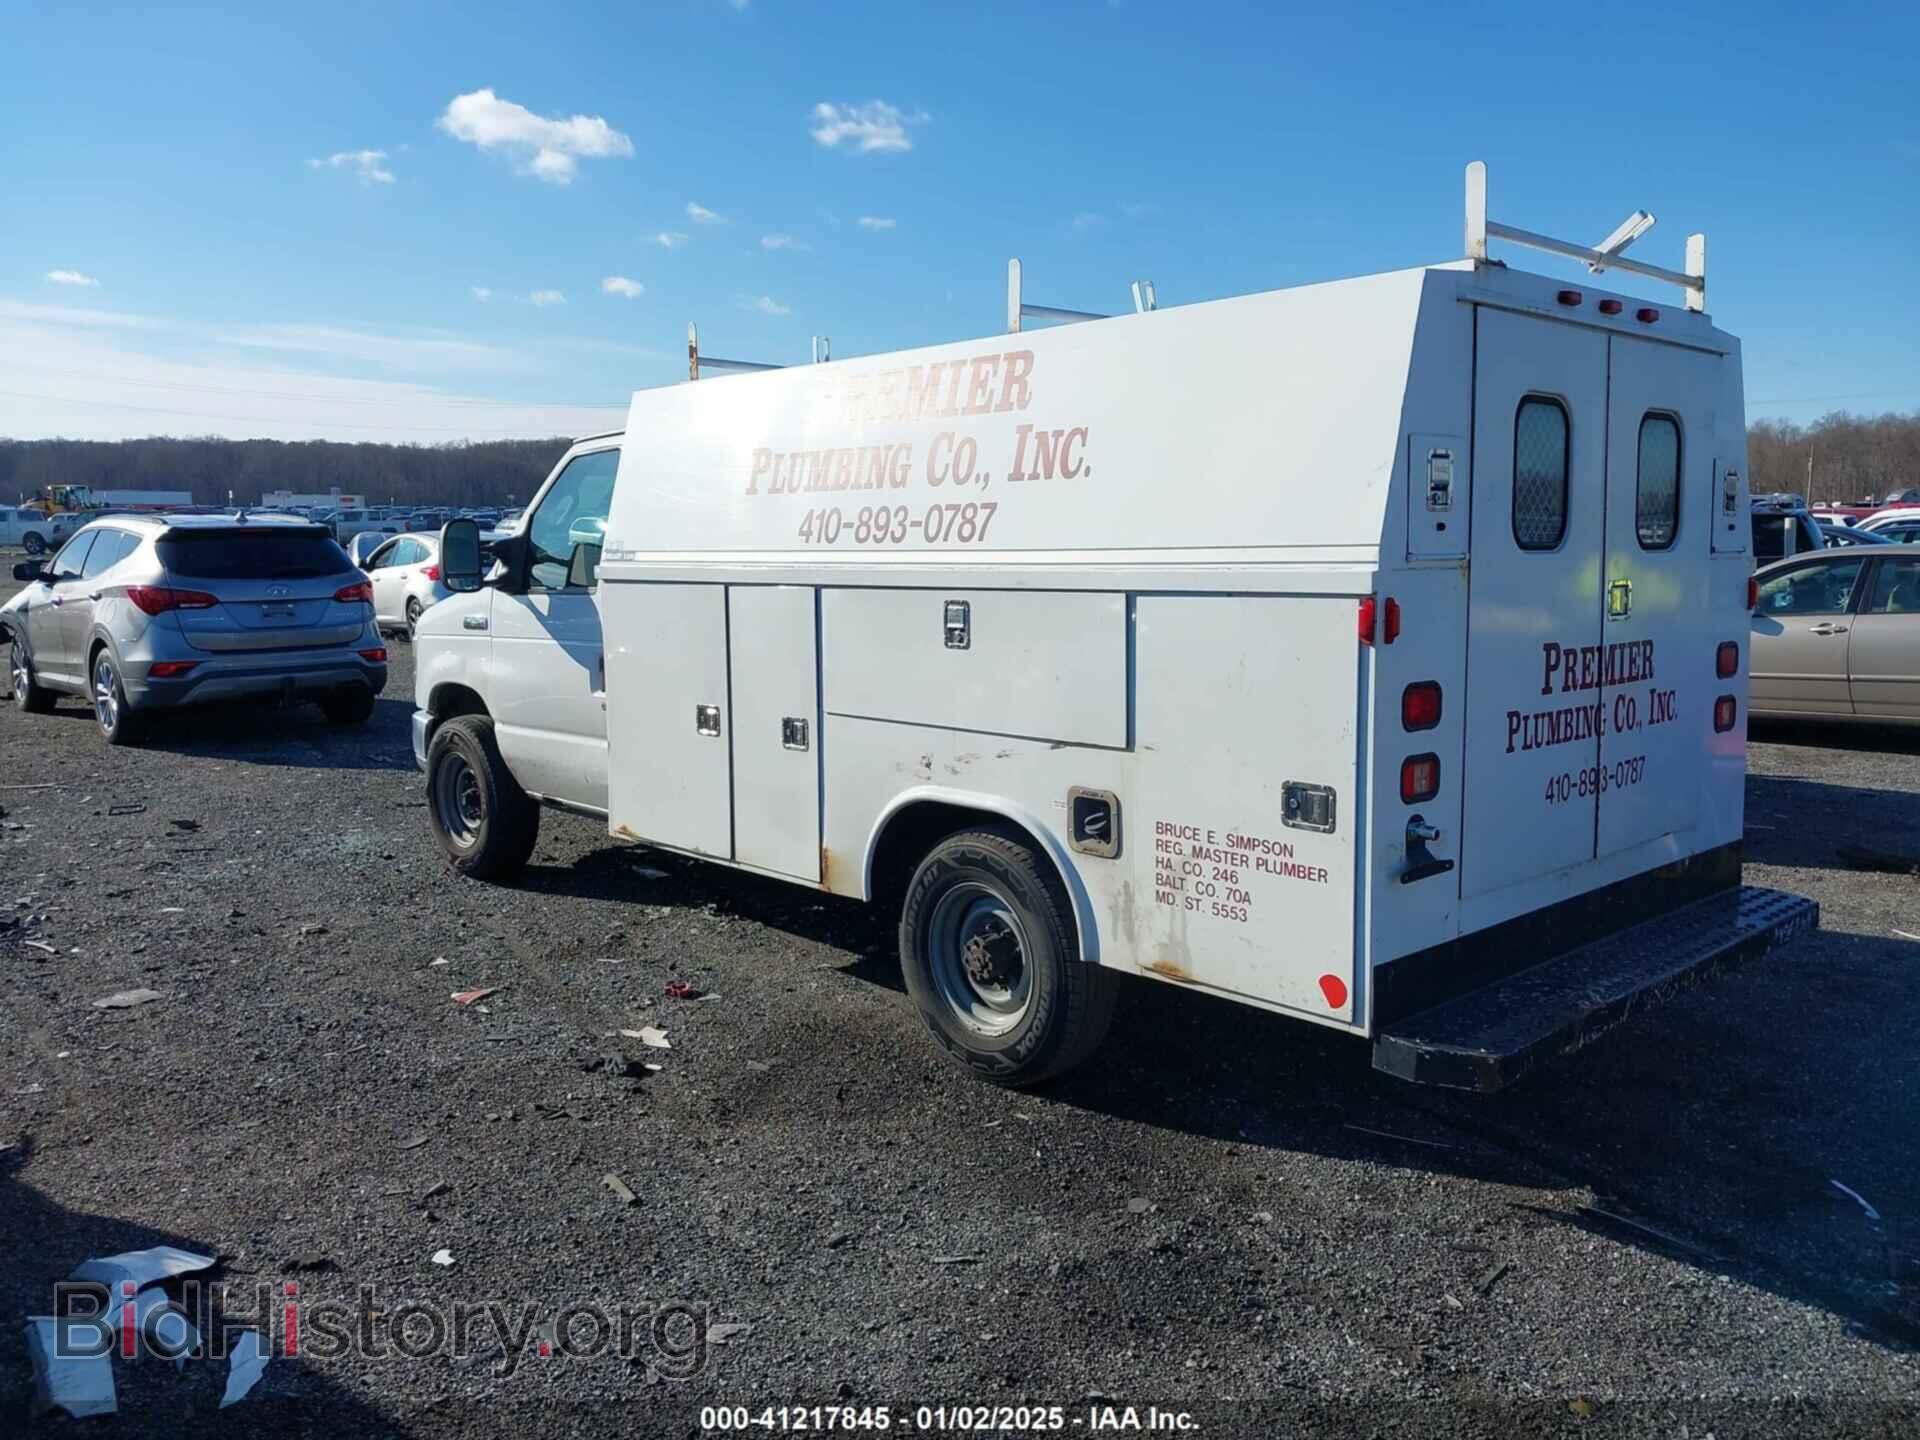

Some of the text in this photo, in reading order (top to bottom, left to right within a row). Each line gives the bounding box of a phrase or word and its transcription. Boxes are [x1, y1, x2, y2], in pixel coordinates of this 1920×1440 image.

[745, 442, 913, 495] PLUMBING
[1007, 424, 1092, 483] INC.
[797, 501, 998, 544] 410-893-0787
[1541, 639, 1655, 695] PREMIER
[1505, 703, 1607, 753] PLUMBING
[1647, 688, 1678, 726] INC.
[1545, 755, 1646, 804] 410-893-0787
[1155, 821, 1294, 858] BRUCE E. SIMPSON
[1155, 839, 1329, 883] REG. MASTER PLUMBER
[1155, 856, 1239, 885] HA. CO. 246
[1155, 872, 1252, 905] BALT. CO. 70A
[1155, 890, 1248, 922] MD. ST. 5553
